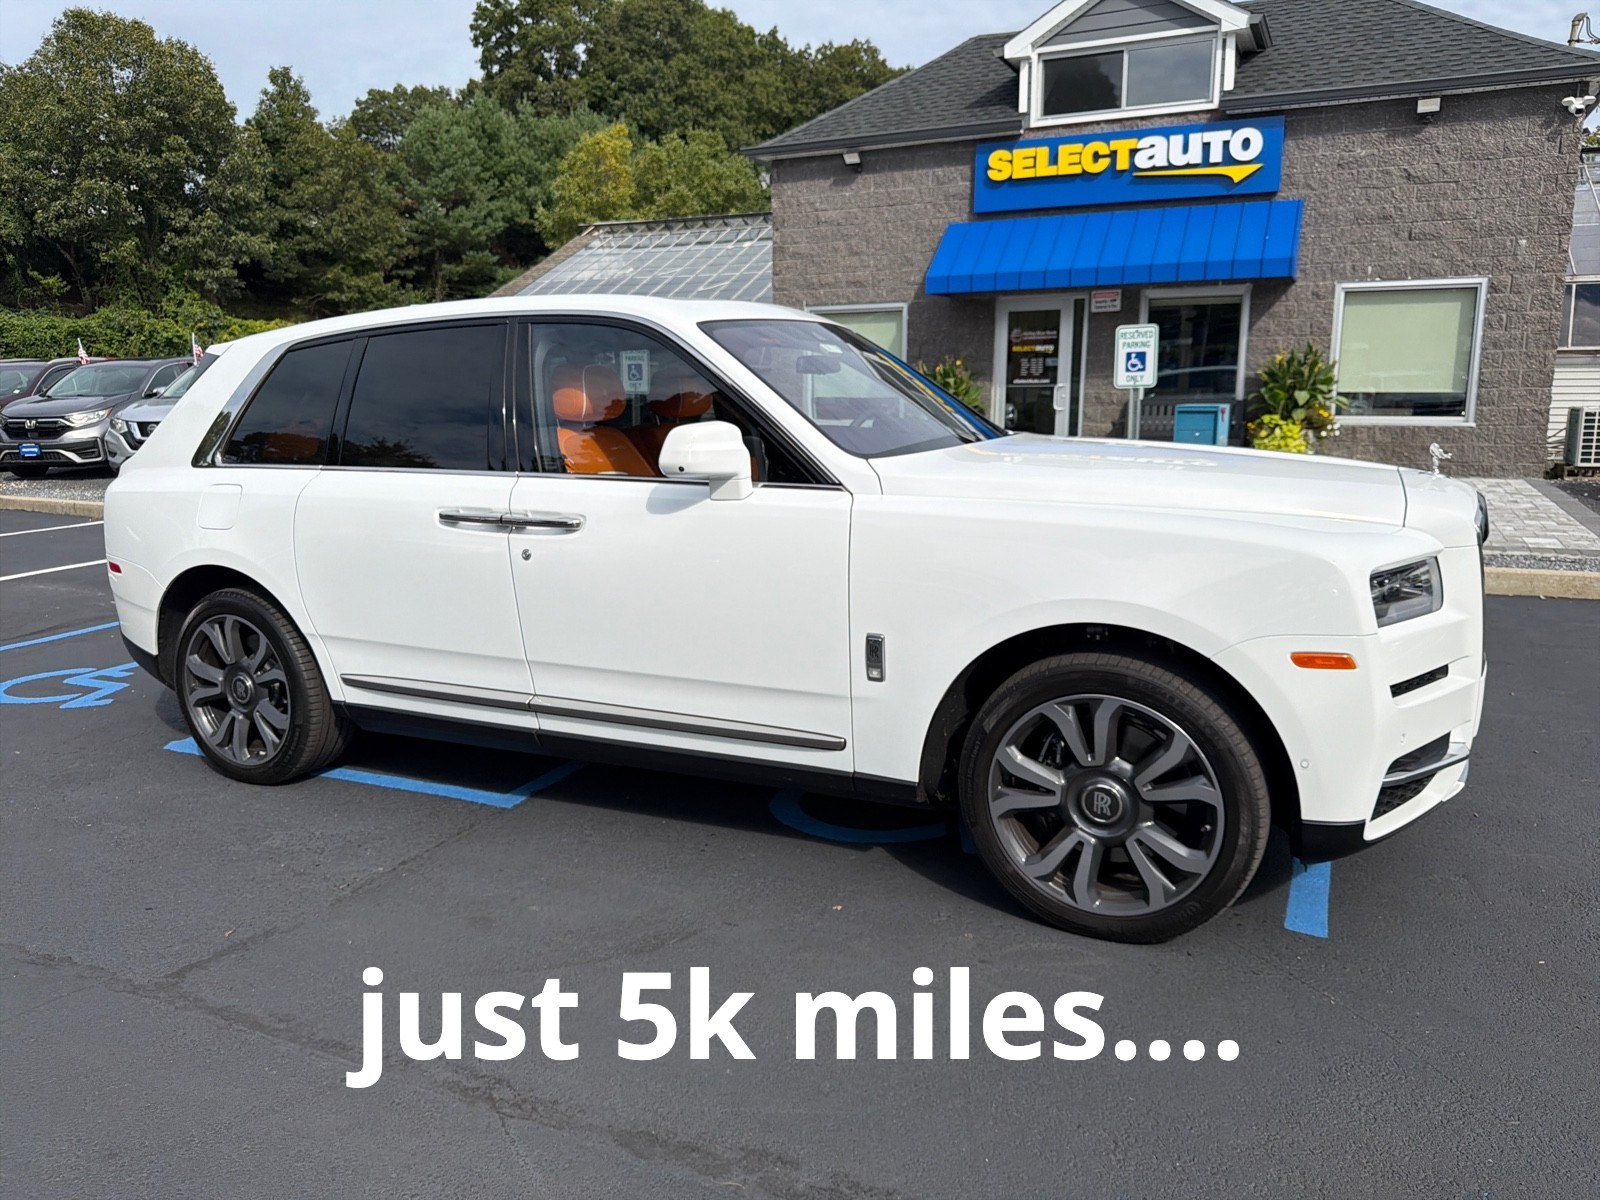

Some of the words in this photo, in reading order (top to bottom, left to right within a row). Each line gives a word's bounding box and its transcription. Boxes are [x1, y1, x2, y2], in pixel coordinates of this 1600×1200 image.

[1120, 330, 1154, 340] RESERVED
[1122, 341, 1151, 350] PARKING
[1126, 374, 1145, 384] ONLY
